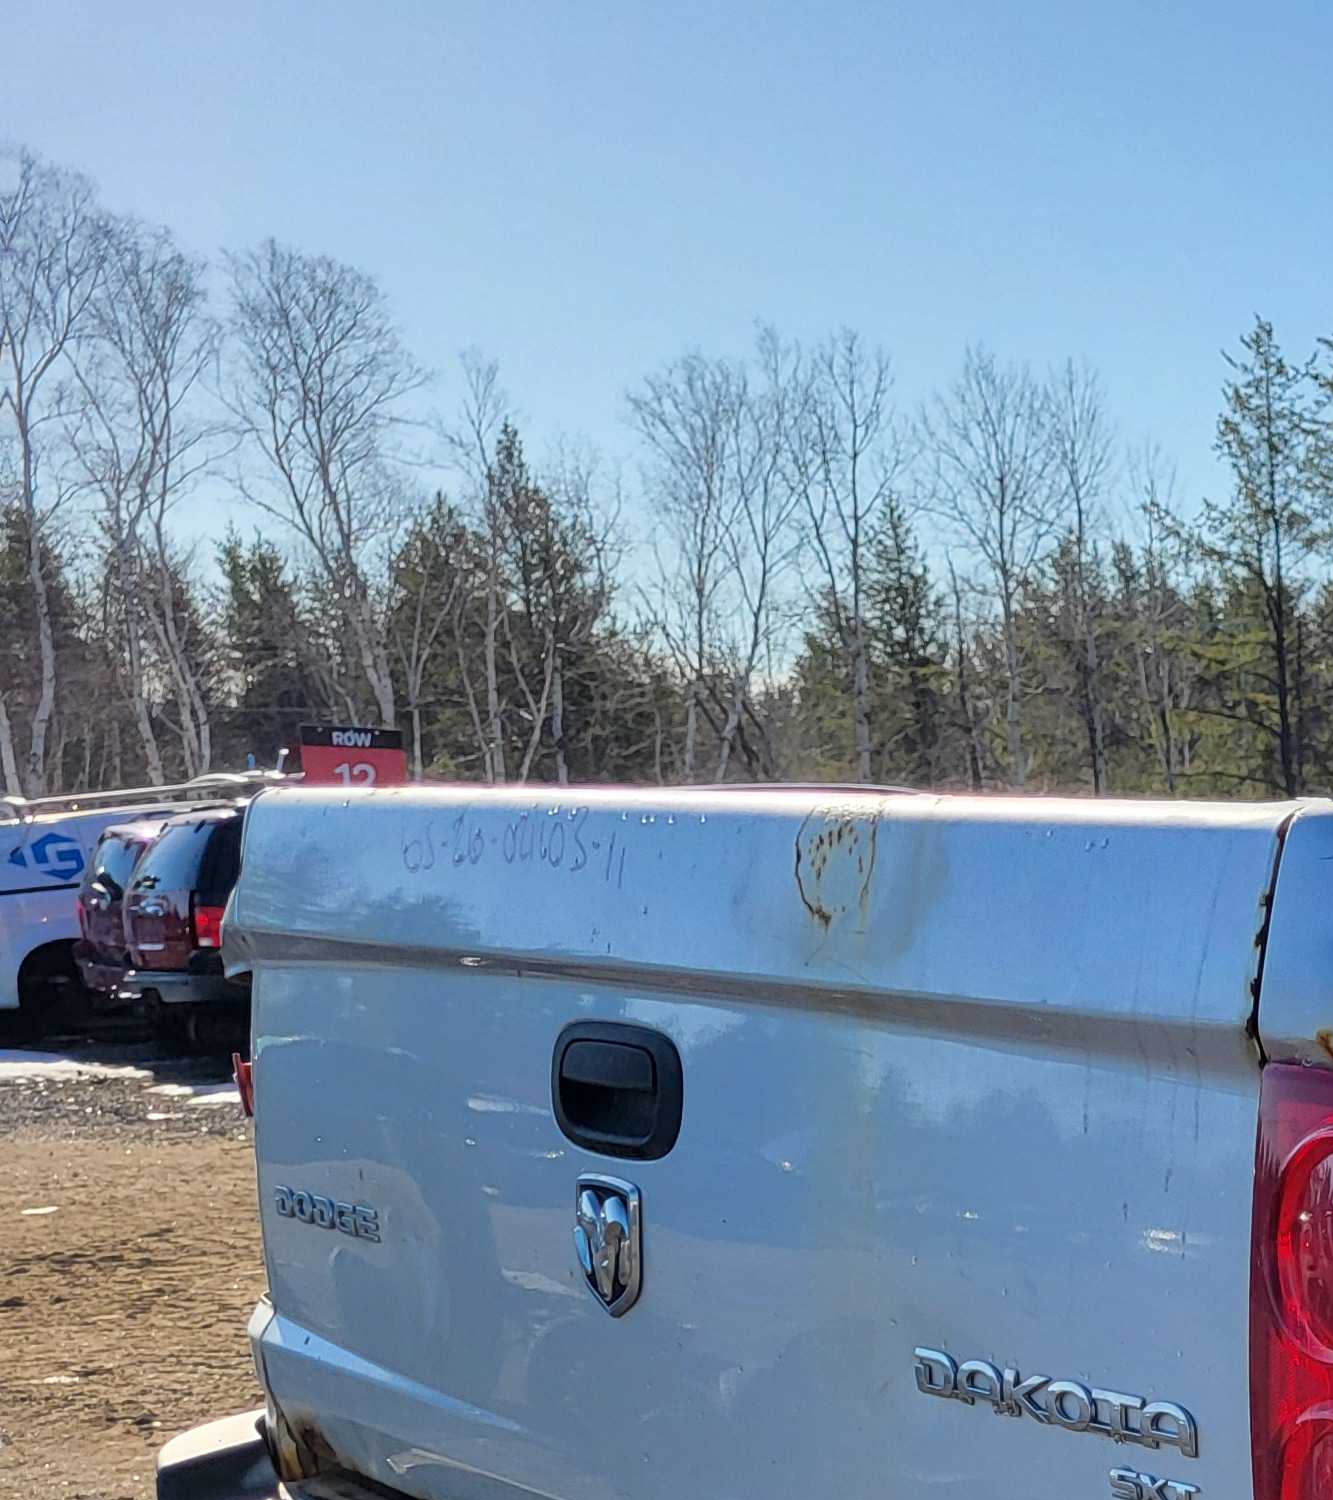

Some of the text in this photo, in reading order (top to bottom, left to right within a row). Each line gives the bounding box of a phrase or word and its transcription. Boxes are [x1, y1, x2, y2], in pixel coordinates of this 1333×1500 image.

[332, 730, 372, 747] ROW
[335, 763, 377, 788] 12
[274, 1184, 381, 1243] DODGE
[914, 1346, 1199, 1458] DAKOTA
